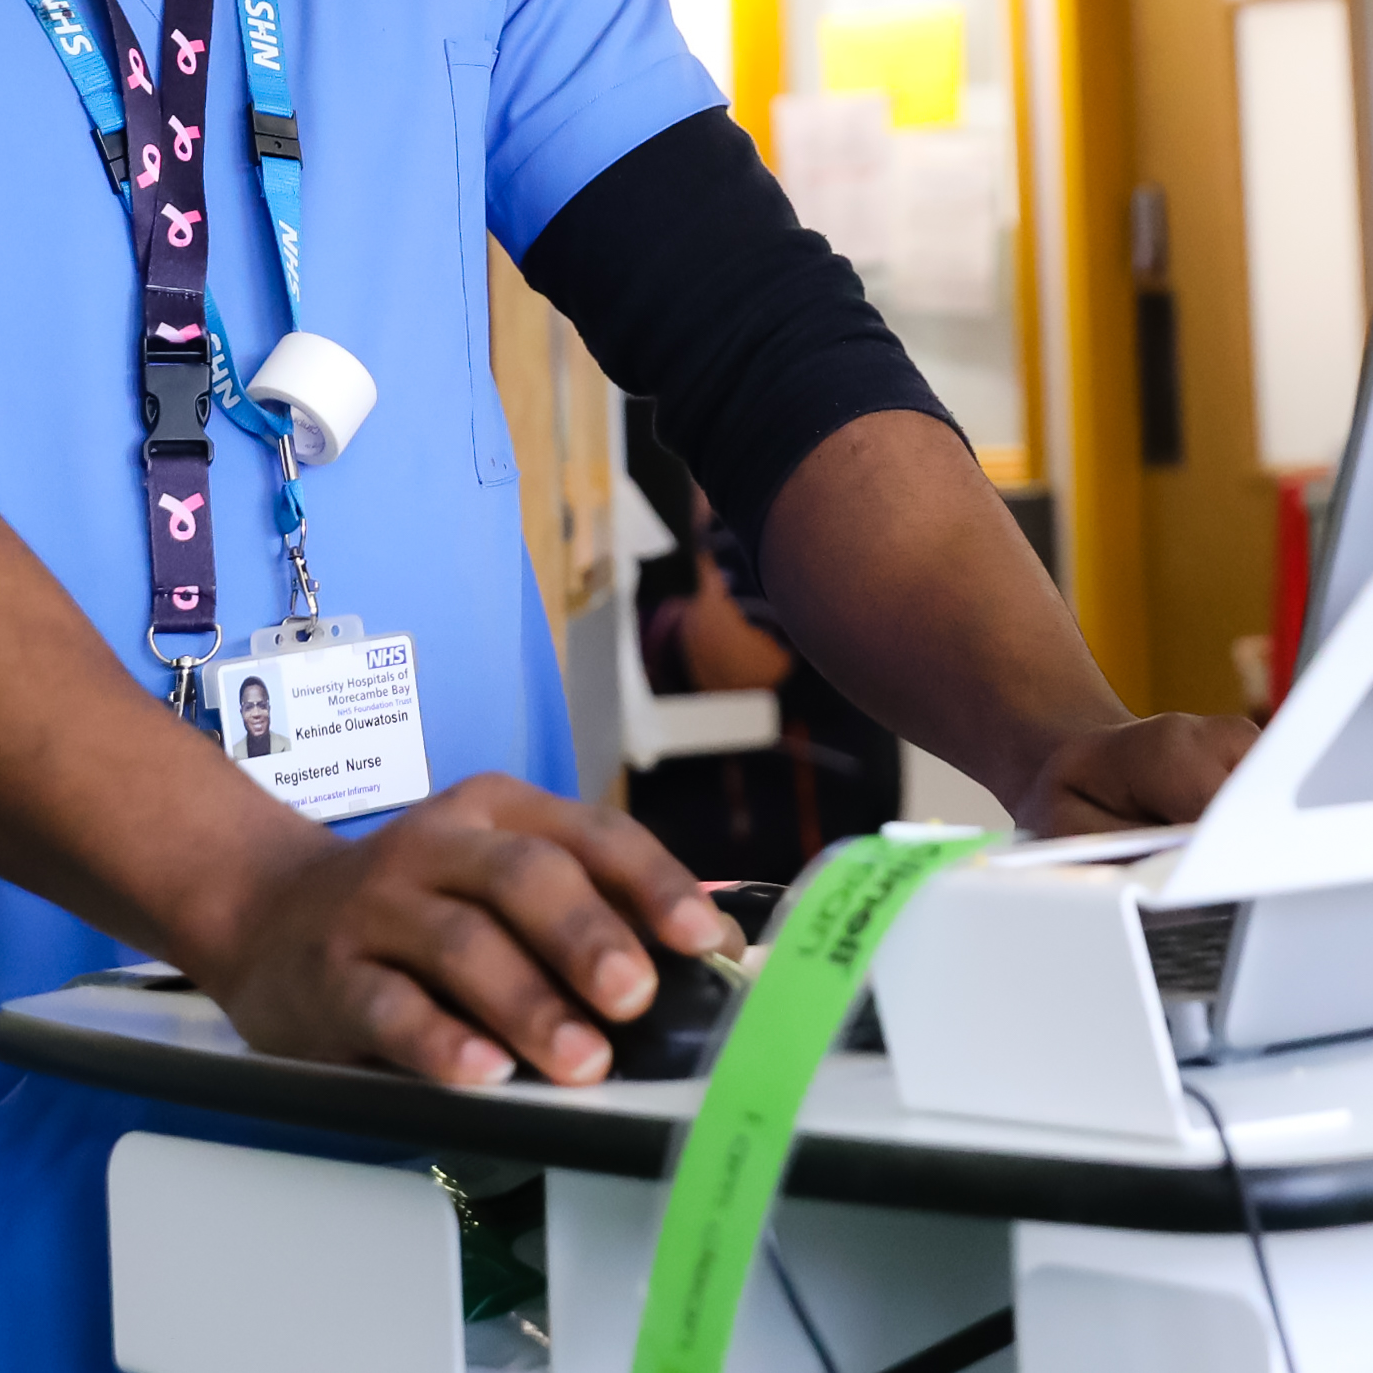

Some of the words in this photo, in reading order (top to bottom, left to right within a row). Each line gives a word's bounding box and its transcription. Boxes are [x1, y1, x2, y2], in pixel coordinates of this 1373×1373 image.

[278, 219, 300, 303] NHS
[368, 646, 406, 669] NHS
[291, 680, 344, 698] University
[347, 671, 395, 689] Hospitals
[397, 668, 409, 680] of
[328, 688, 388, 706] Morecambe
[391, 684, 411, 696] Bay
[337, 707, 352, 716] NHS
[353, 701, 394, 714] Foundation
[395, 697, 412, 706] Trust
[295, 722, 342, 740] Kehinde
[344, 710, 409, 732] Oluwatosin
[274, 761, 340, 786] Registered
[346, 756, 382, 773] Nurse
[309, 790, 346, 804] Lancaster
[347, 783, 381, 797] Infirmary
